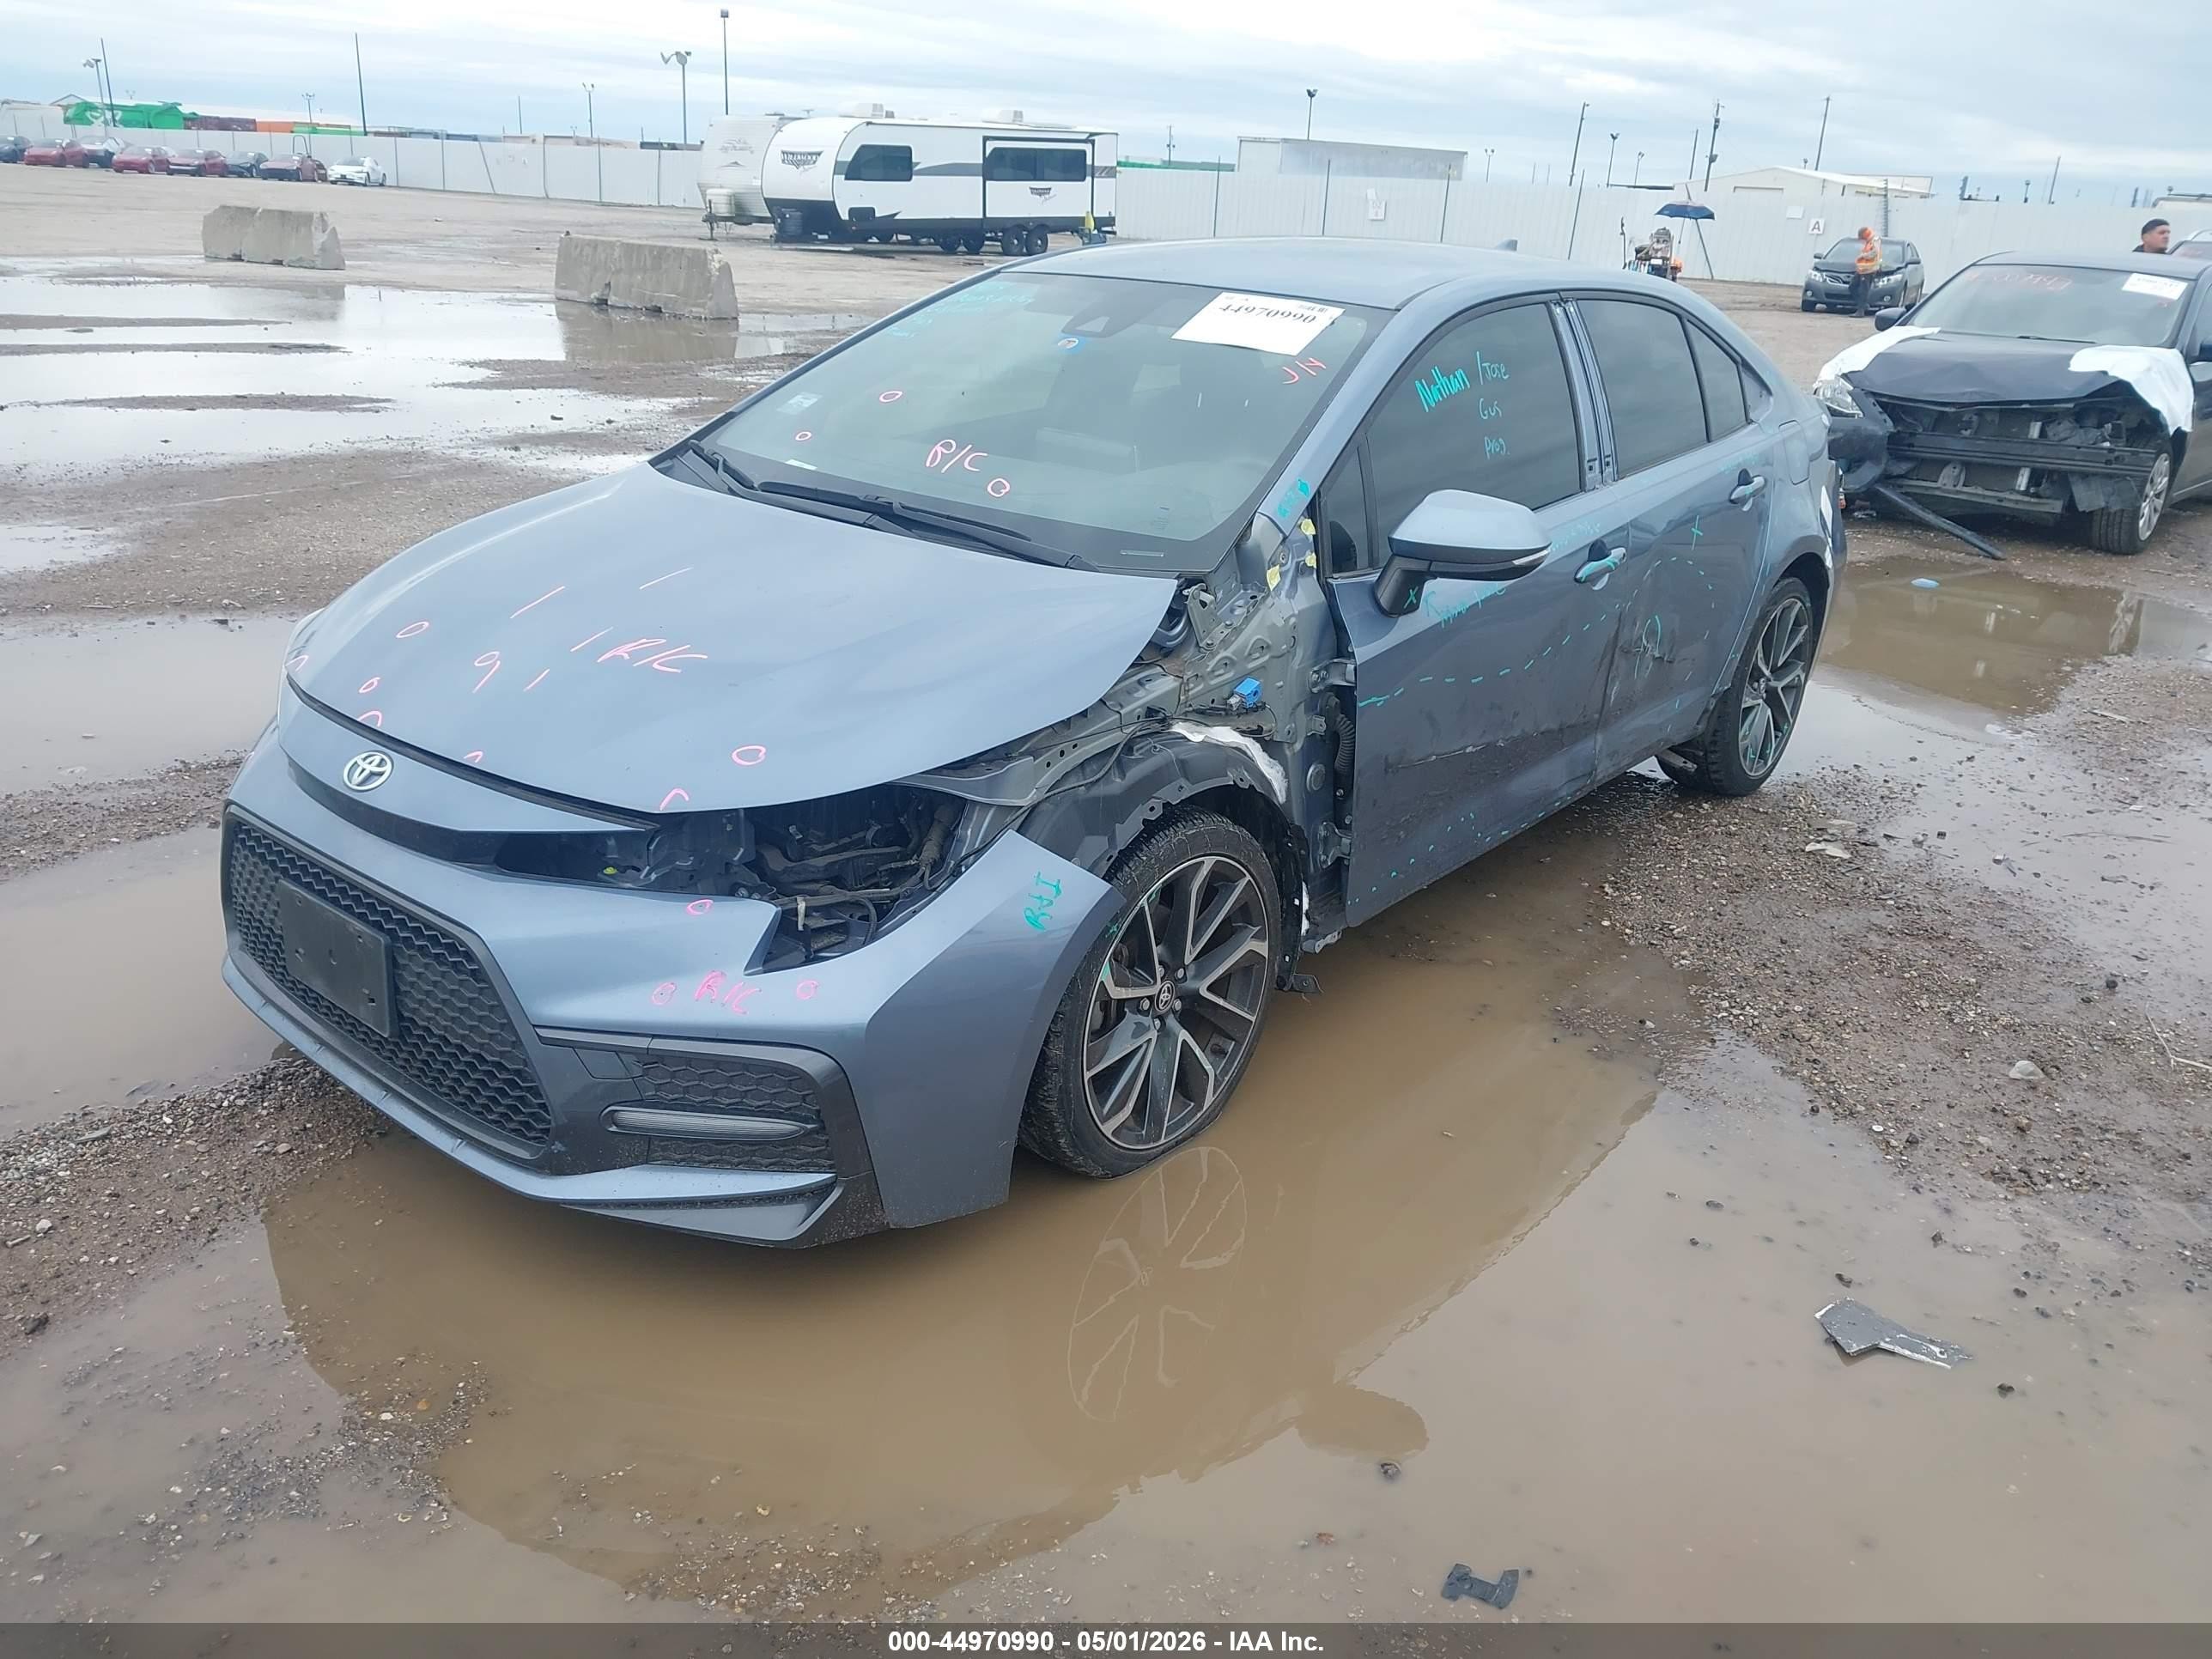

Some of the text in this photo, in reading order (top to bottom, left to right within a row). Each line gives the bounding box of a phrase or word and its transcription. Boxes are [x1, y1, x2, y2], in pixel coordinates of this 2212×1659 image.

[1811, 221, 1820, 232] A
[1219, 303, 1316, 324] 44970990
[1415, 366, 1470, 412] Nathan
[926, 439, 988, 473] R/C
